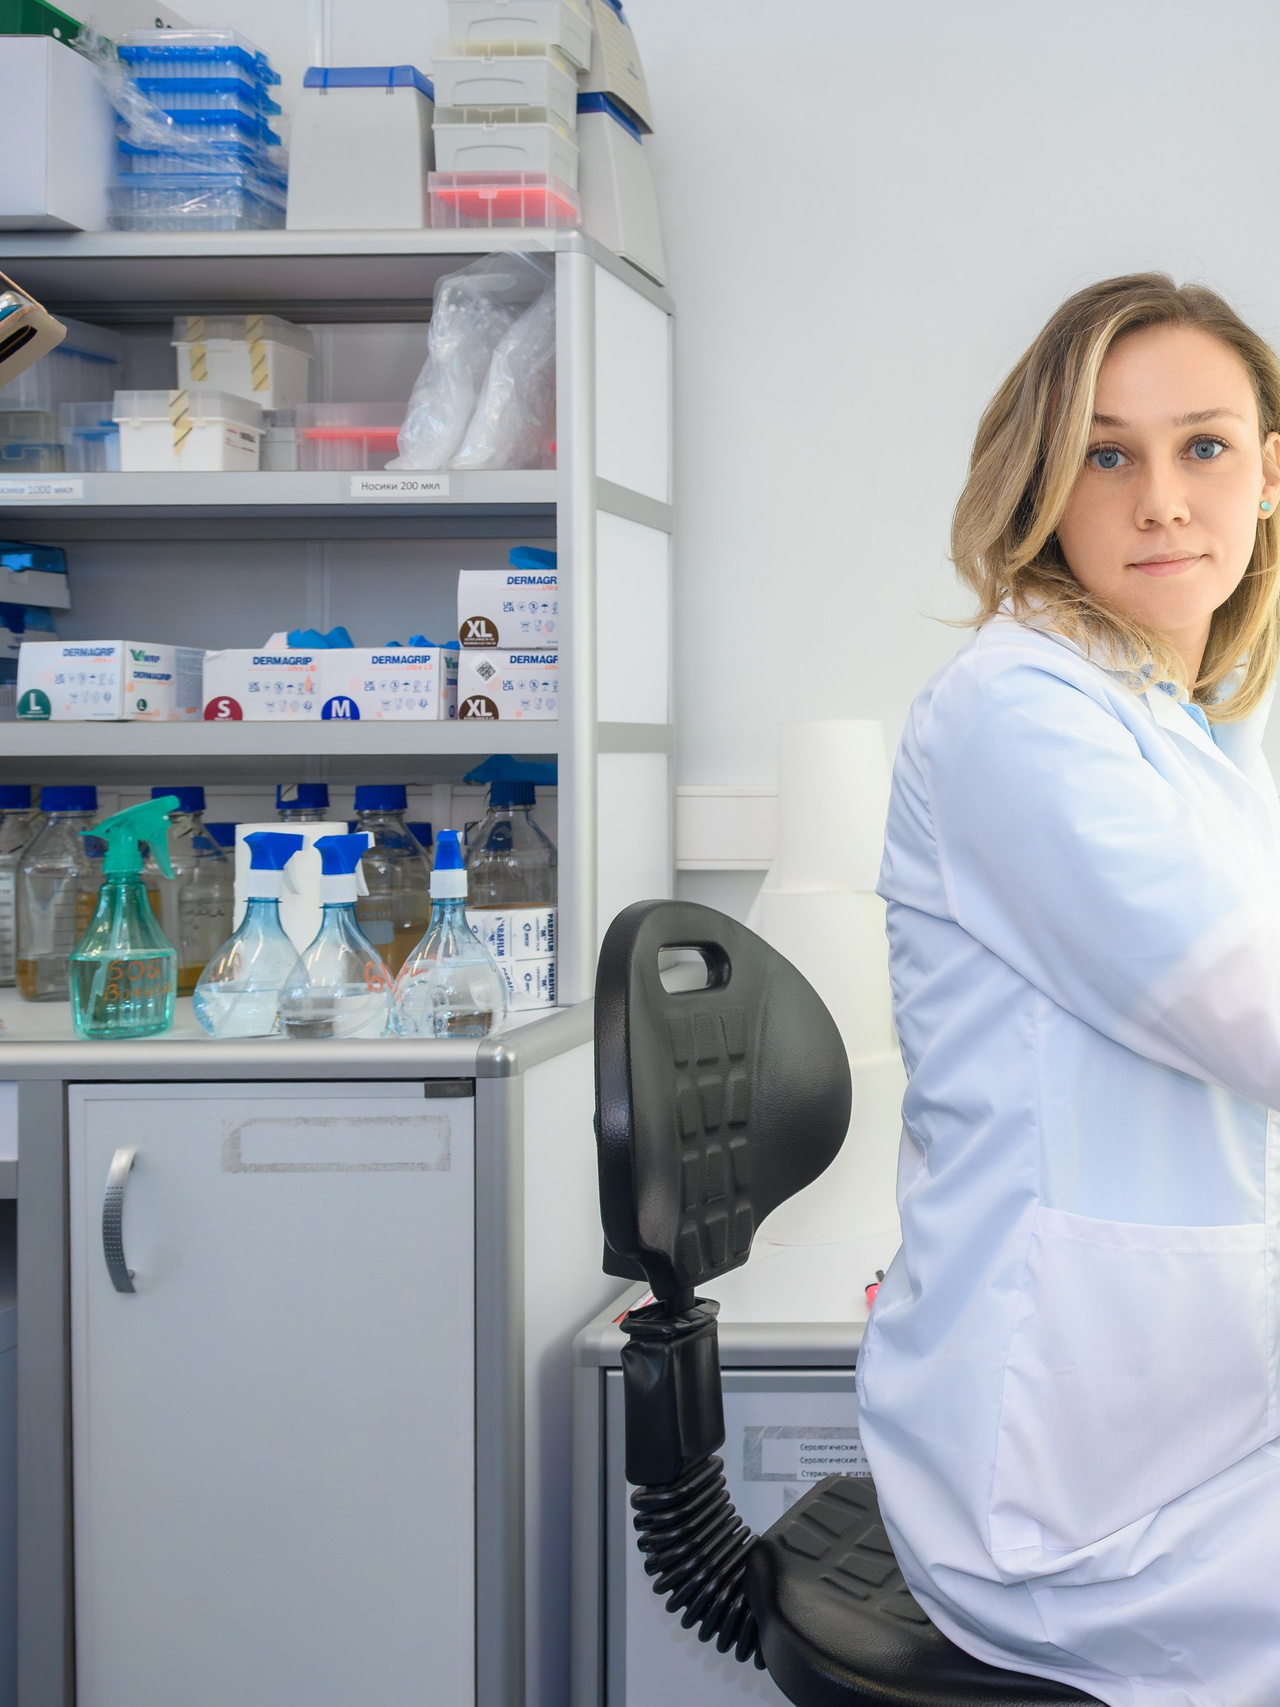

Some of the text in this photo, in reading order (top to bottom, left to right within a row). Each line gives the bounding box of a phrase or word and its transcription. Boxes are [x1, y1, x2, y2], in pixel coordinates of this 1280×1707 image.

[361, 482, 397, 490] Носики
[400, 482, 418, 490] 200
[466, 620, 492, 637] XL
[62, 647, 115, 657] DERMAGRIP
[252, 657, 312, 665] DERMAGRIP
[372, 655, 431, 664] DERMAGRIP
[30, 693, 41, 710] L
[218, 700, 231, 717] S
[332, 700, 351, 717] M
[466, 700, 492, 717] XL
[800, 1443, 857, 1451] Серологические
